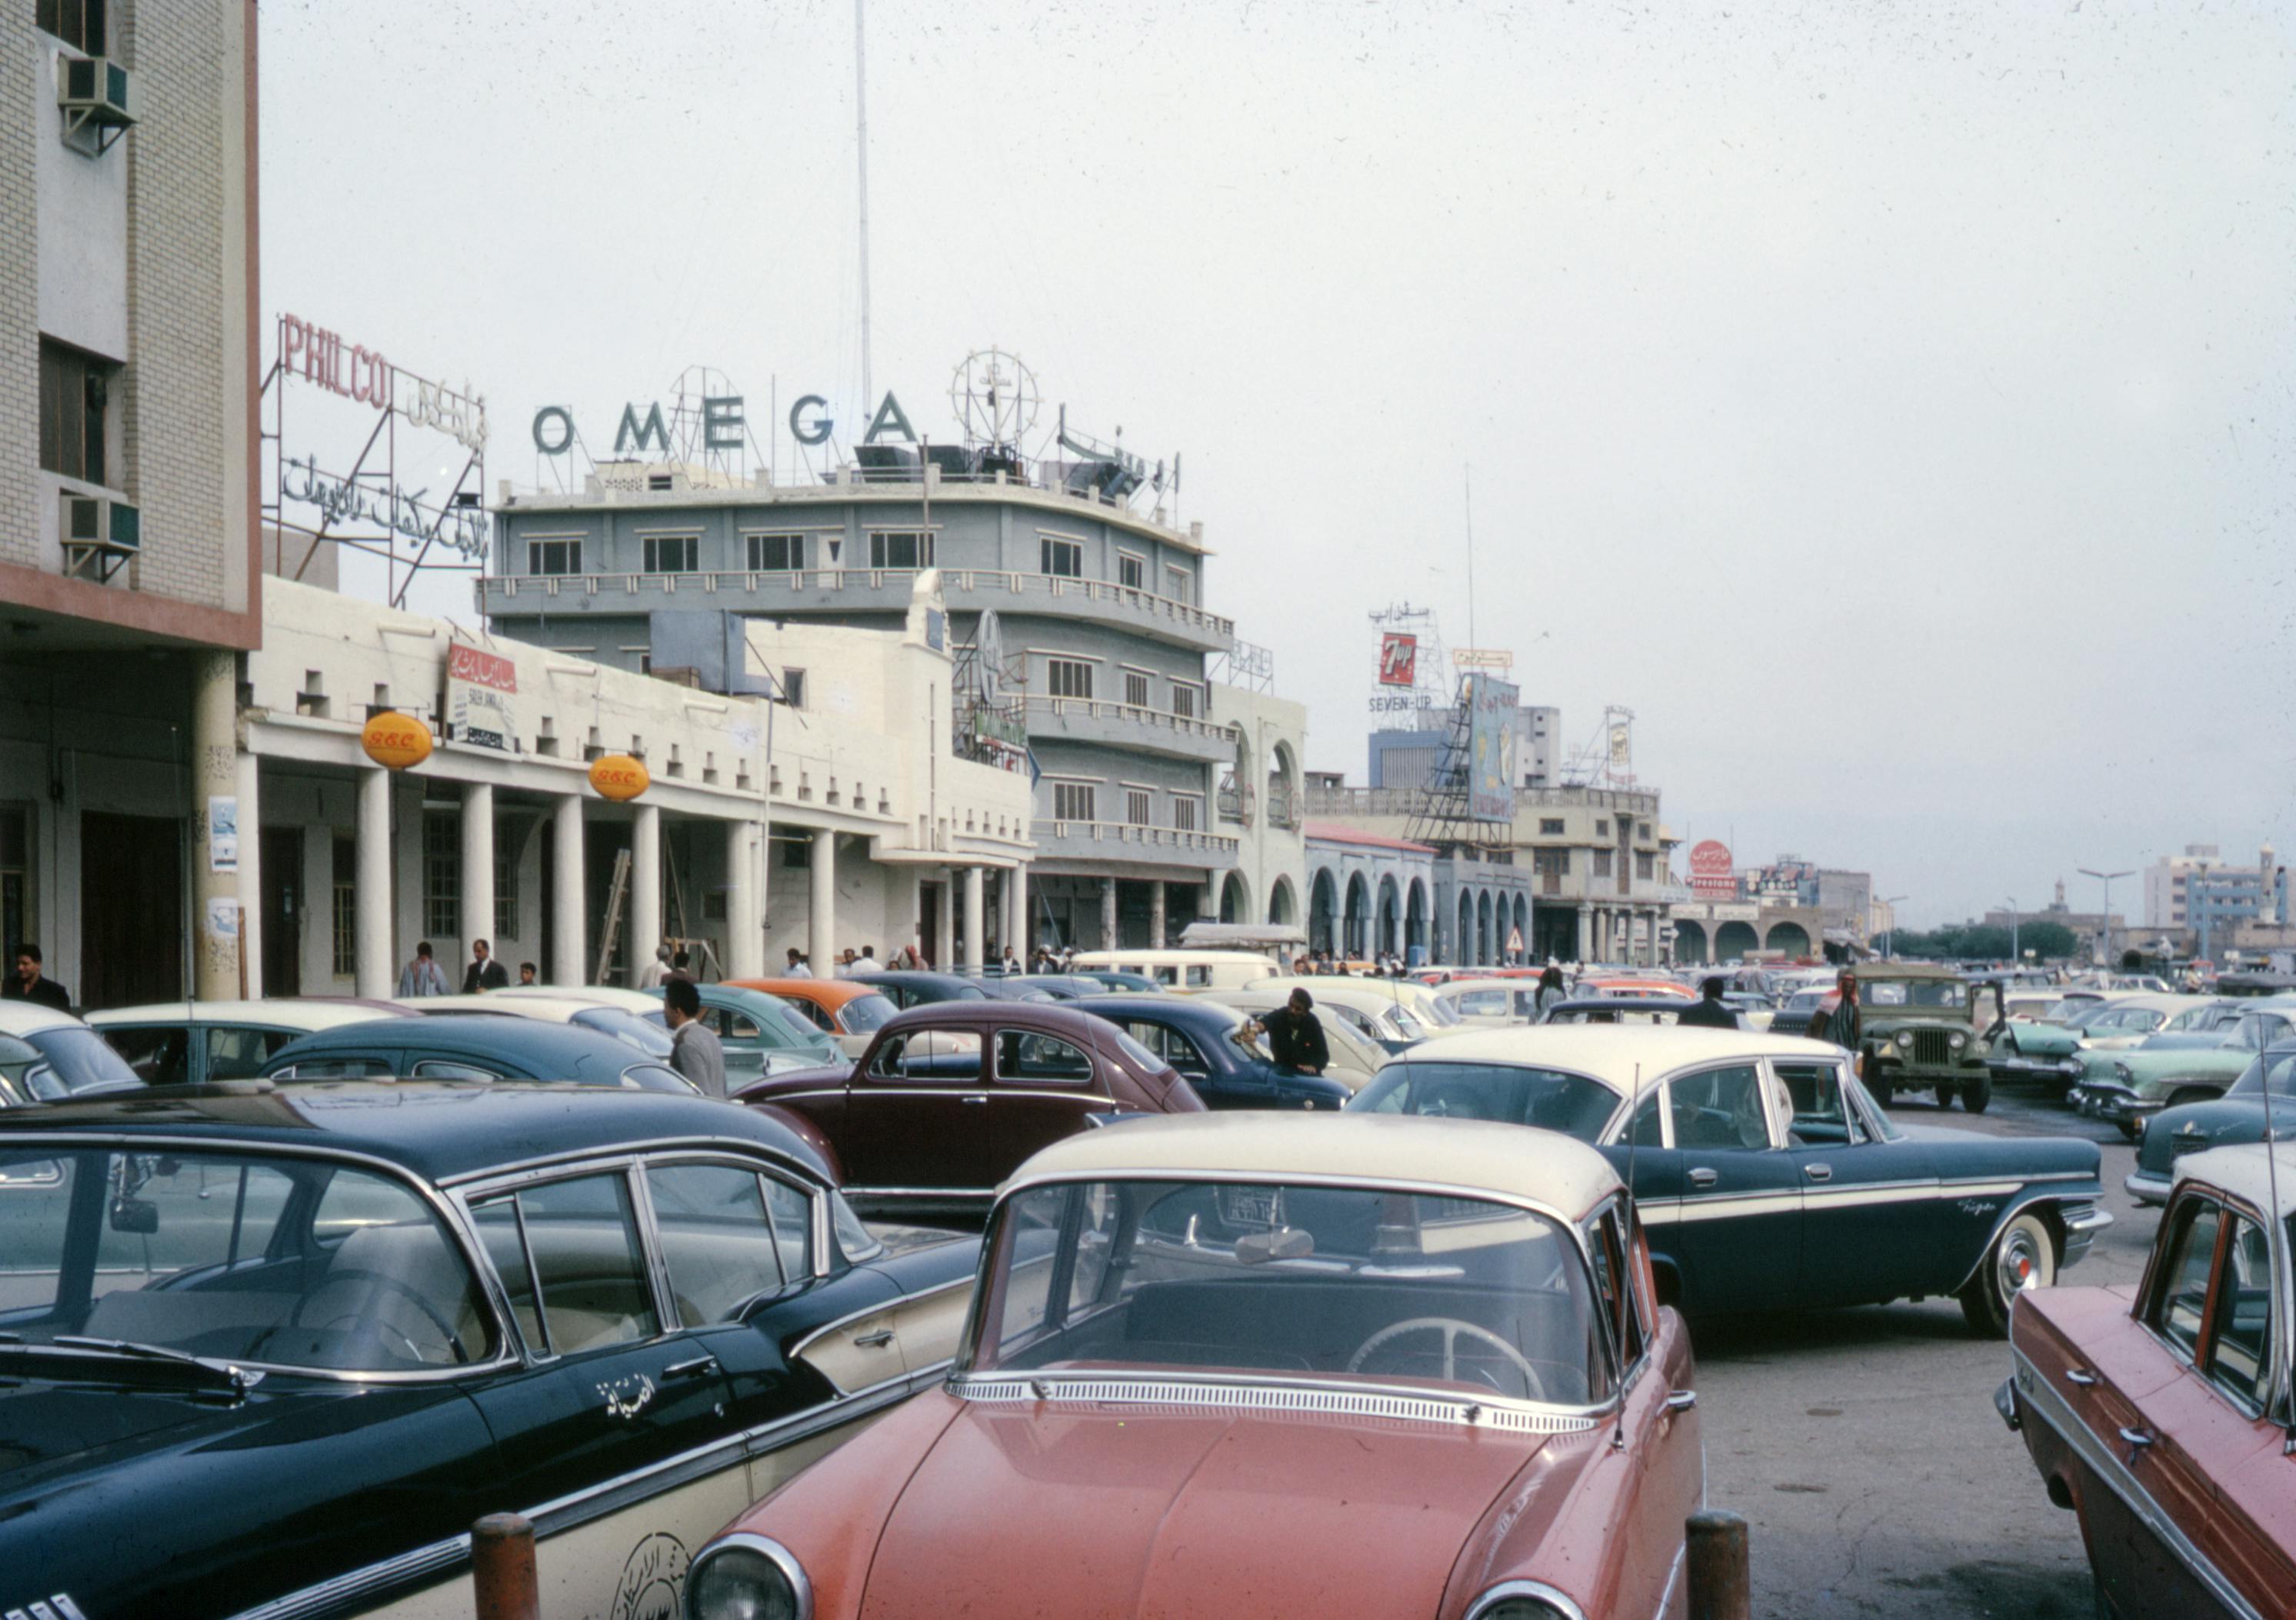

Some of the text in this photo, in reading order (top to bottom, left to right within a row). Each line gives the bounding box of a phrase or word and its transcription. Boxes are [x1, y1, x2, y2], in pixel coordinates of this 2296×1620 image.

[285, 313, 387, 409] PHILCO
[532, 389, 918, 455] OMEGA
[1368, 695, 1431, 712] SEVEN-UP
